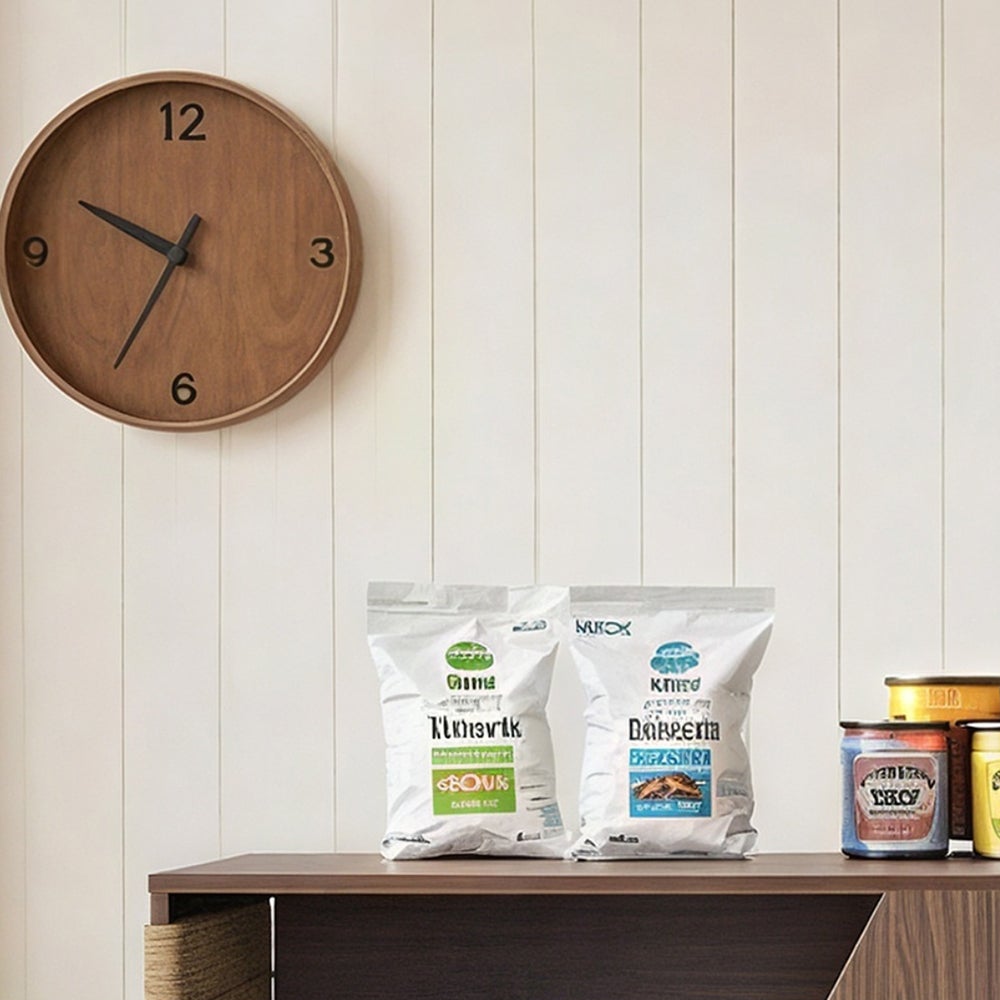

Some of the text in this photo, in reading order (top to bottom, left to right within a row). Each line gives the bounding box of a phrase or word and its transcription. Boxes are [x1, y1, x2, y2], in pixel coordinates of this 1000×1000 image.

[160, 101, 207, 141] 12
[23, 236, 49, 267] 9
[309, 237, 335, 268] 3
[171, 372, 197, 405] 6
